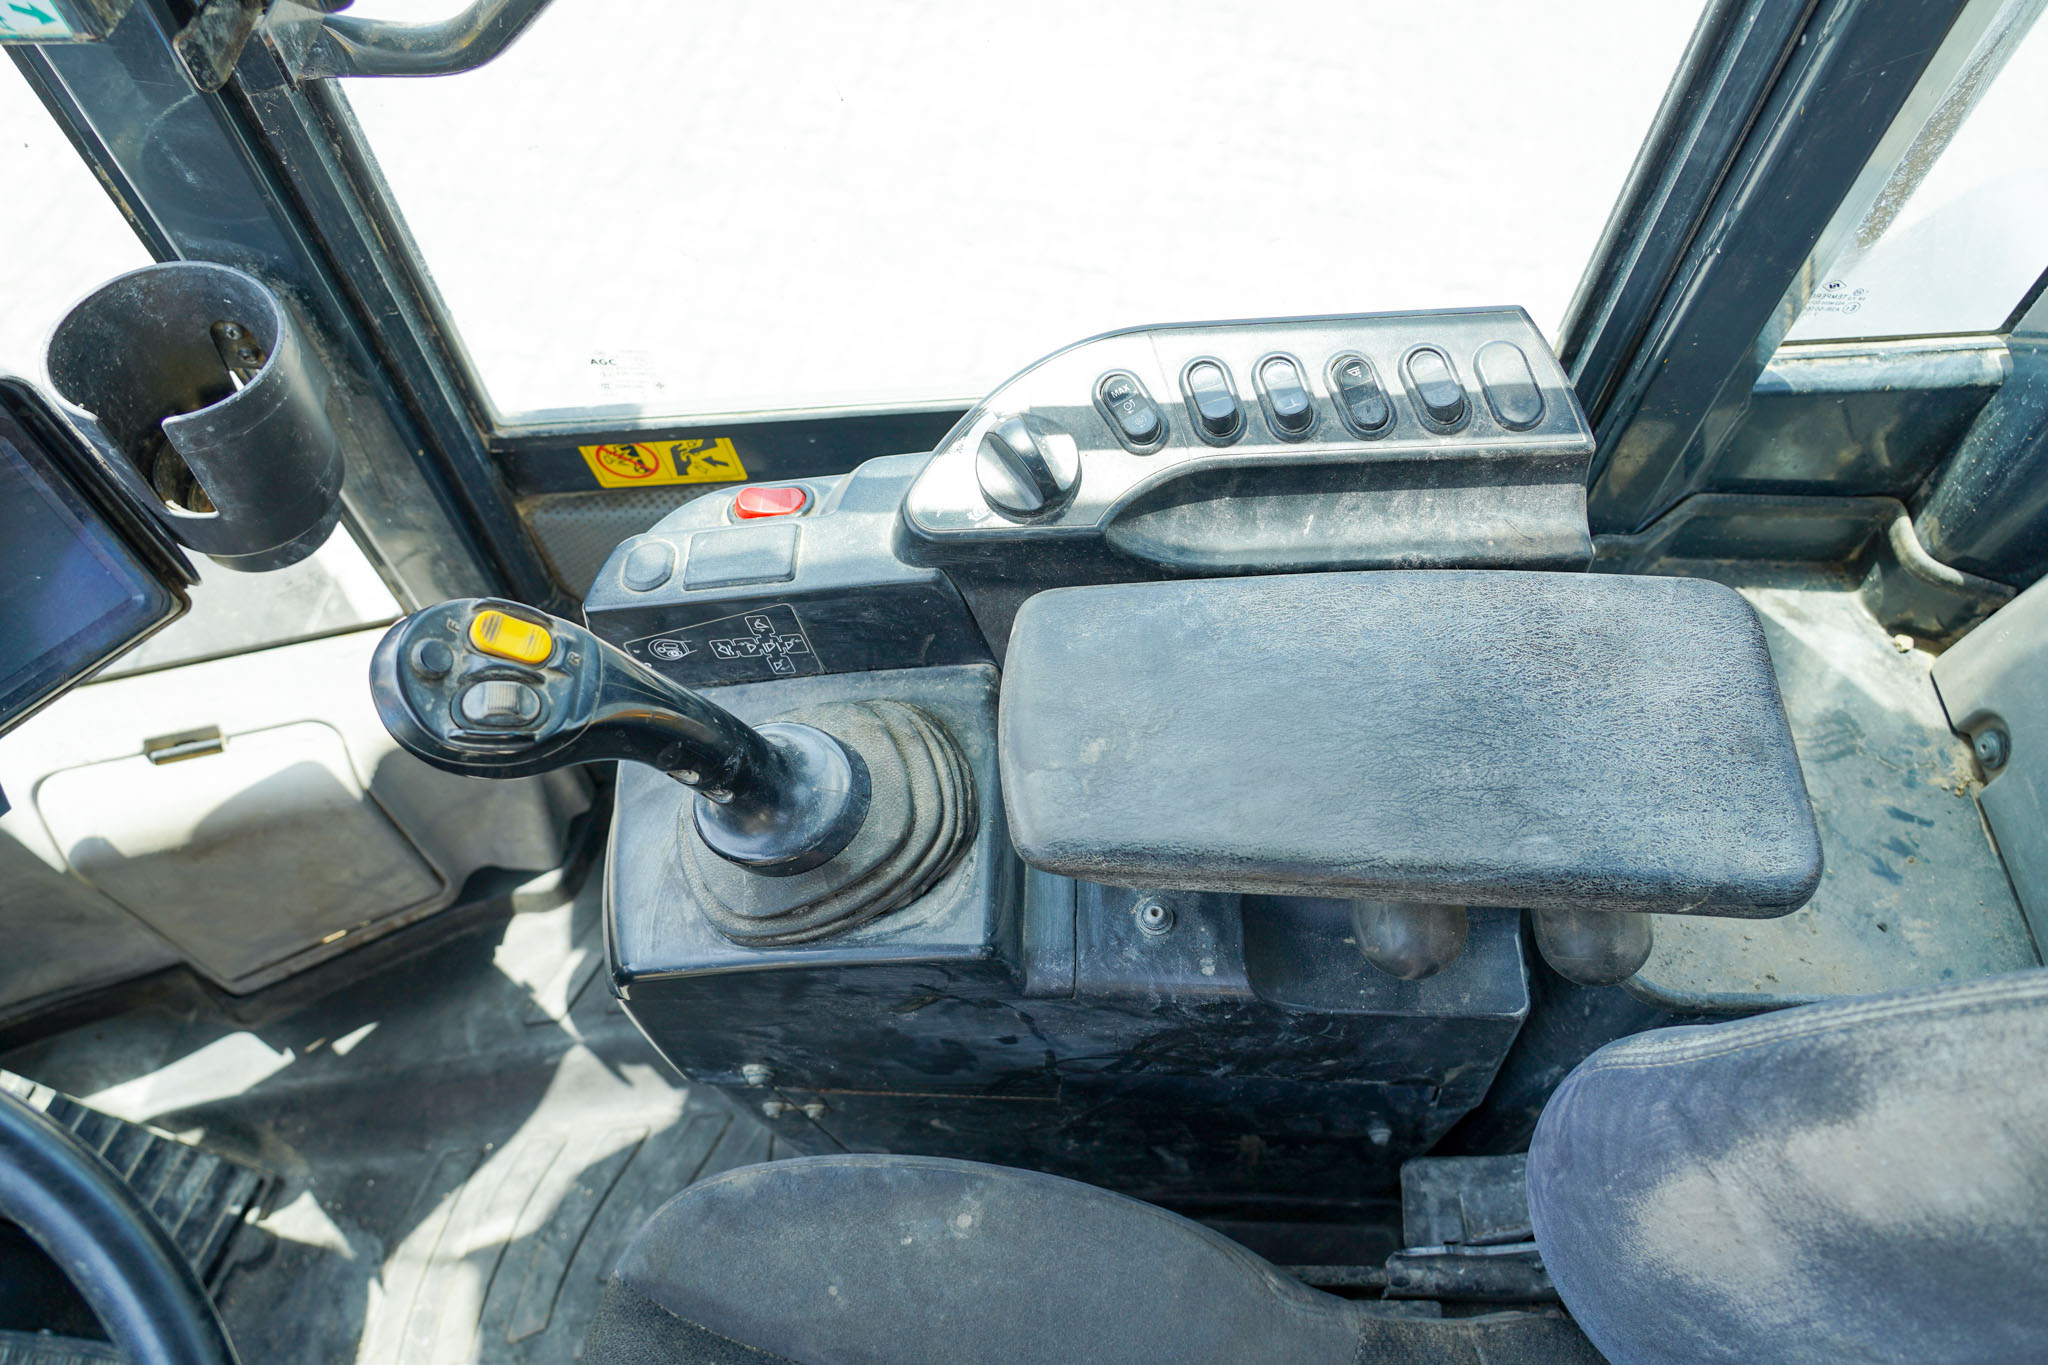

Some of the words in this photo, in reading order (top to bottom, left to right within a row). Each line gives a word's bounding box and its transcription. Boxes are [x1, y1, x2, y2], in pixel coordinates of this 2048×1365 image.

[590, 358, 616, 366] AGC
[1110, 383, 1131, 399] MAX
[447, 617, 460, 633] F
[566, 651, 581, 666] R
